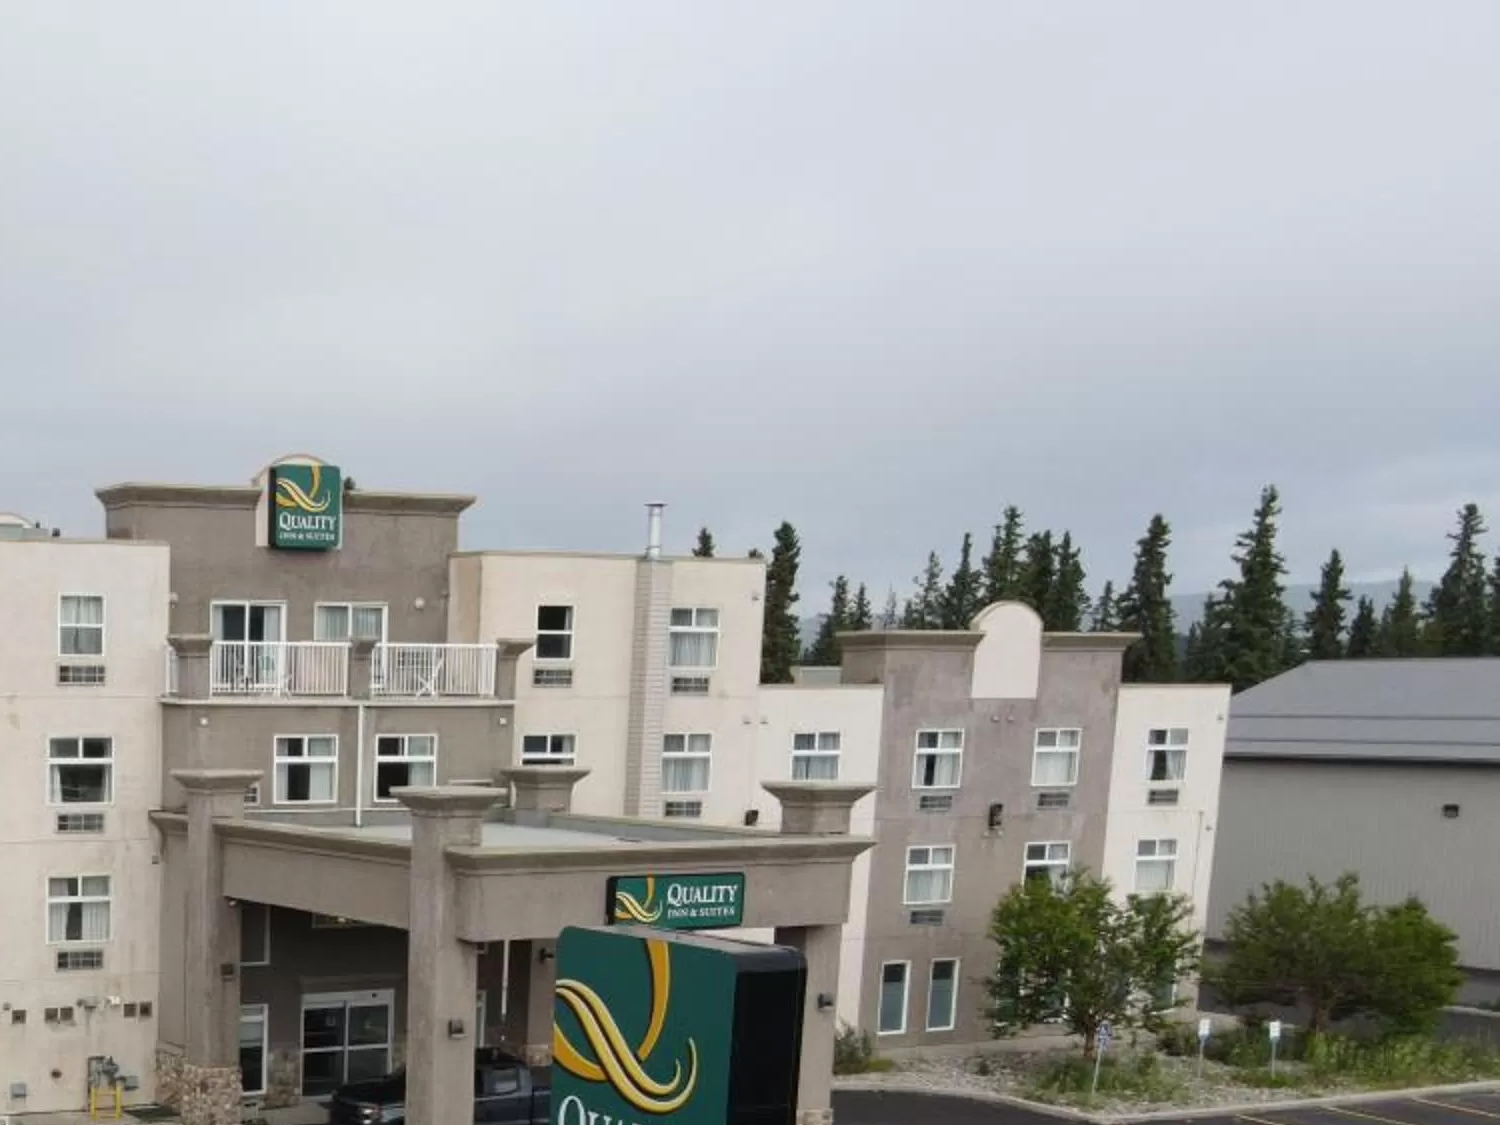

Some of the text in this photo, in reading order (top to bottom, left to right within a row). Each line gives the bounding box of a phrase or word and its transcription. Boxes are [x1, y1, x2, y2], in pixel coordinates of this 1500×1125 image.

[279, 511, 337, 531] QUALITY
[667, 883, 738, 907] QUALITY
[667, 908, 689, 919] INN
[699, 905, 735, 917] SUITES
